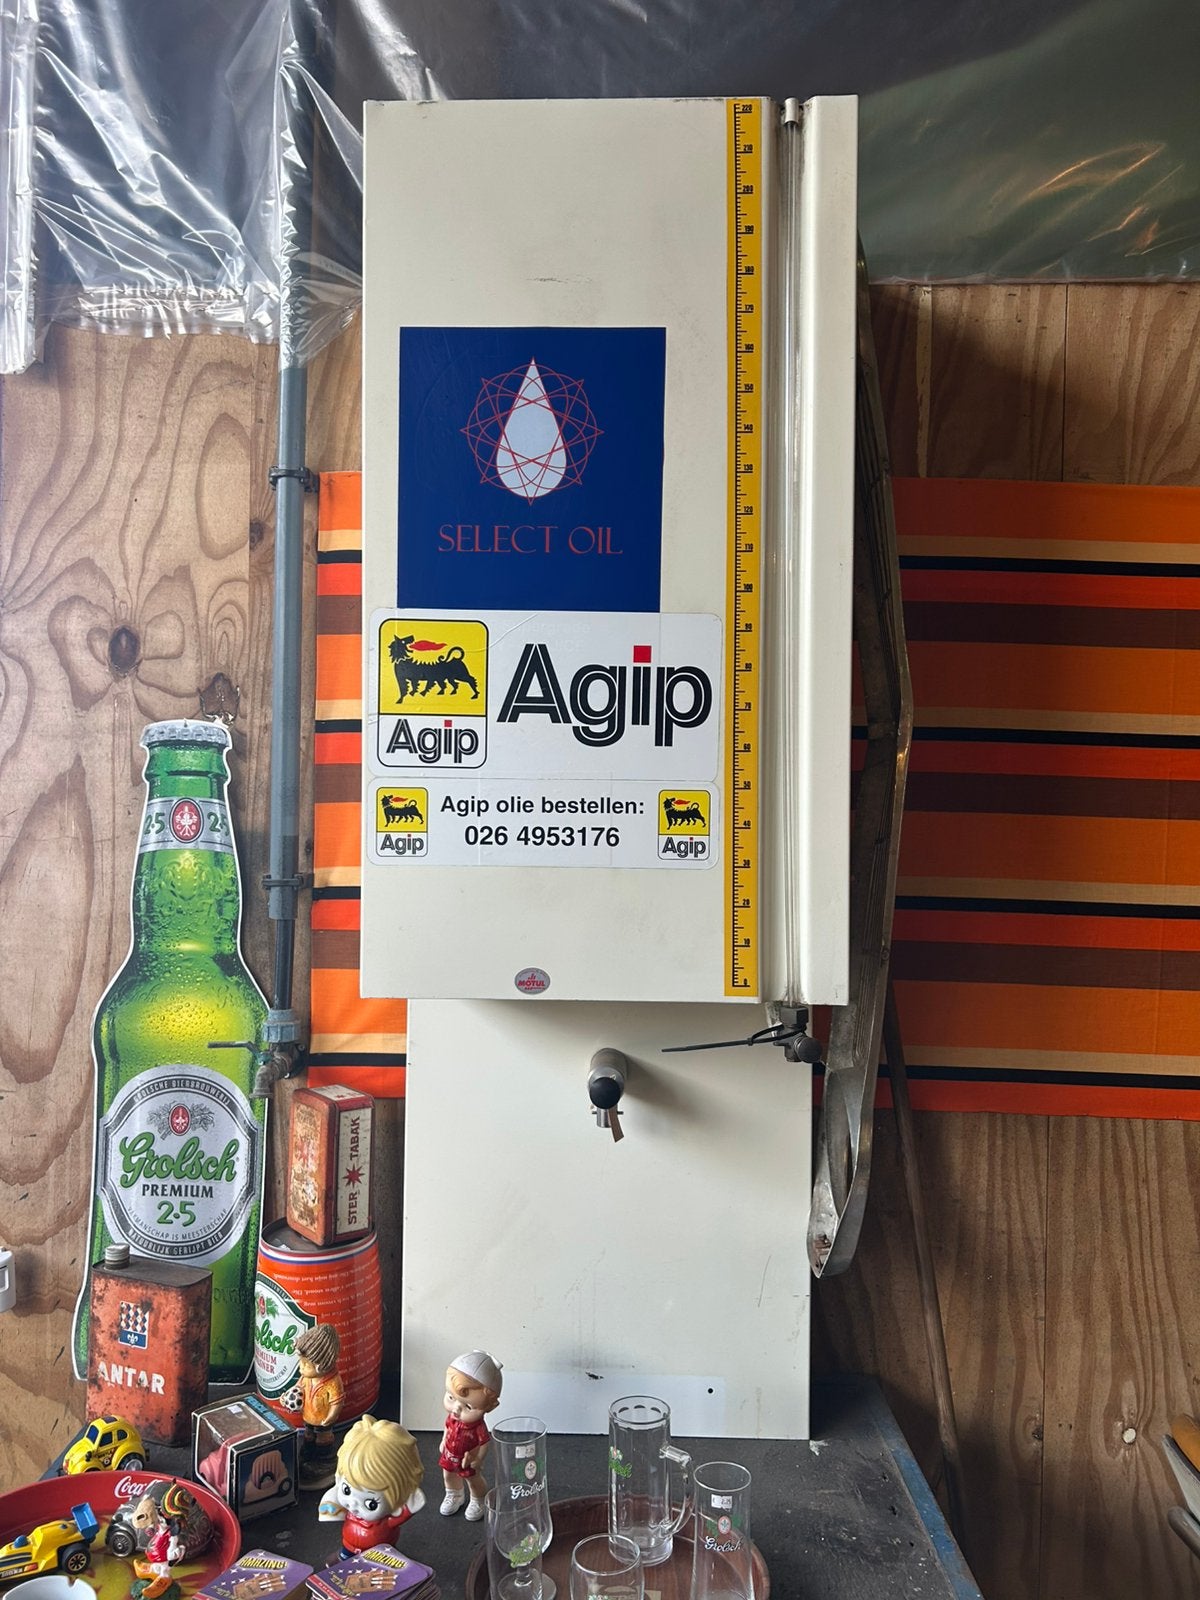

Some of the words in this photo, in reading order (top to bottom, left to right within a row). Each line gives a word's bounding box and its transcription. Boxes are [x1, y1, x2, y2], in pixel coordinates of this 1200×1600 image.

[438, 524, 558, 554] SELECT
[568, 526, 623, 554] OIL
[496, 644, 712, 747] Agip
[386, 718, 480, 764] Agip
[440, 796, 490, 817] Agip
[496, 797, 534, 814] olie
[541, 797, 645, 815] bestellen:
[380, 834, 424, 855] Agip
[465, 826, 508, 846] 026
[516, 826, 620, 847] 4953176
[662, 836, 706, 858] Agip
[350, 1116, 360, 1160] TABAK
[119, 1132, 239, 1188] Grolsch
[142, 1184, 214, 1199] PREMIUM
[348, 1191, 358, 1225] STER
[181, 1208, 228, 1240] MEESTERSCHAP
[128, 1228, 170, 1255] NATUURLIJK
[208, 1232, 223, 1247] BIER
[255, 1319, 295, 1355] olsch
[98, 1360, 165, 1395] ANTAR
[240, 1557, 288, 1570] AMAZING!
[363, 1550, 408, 1569] AMAZING!
